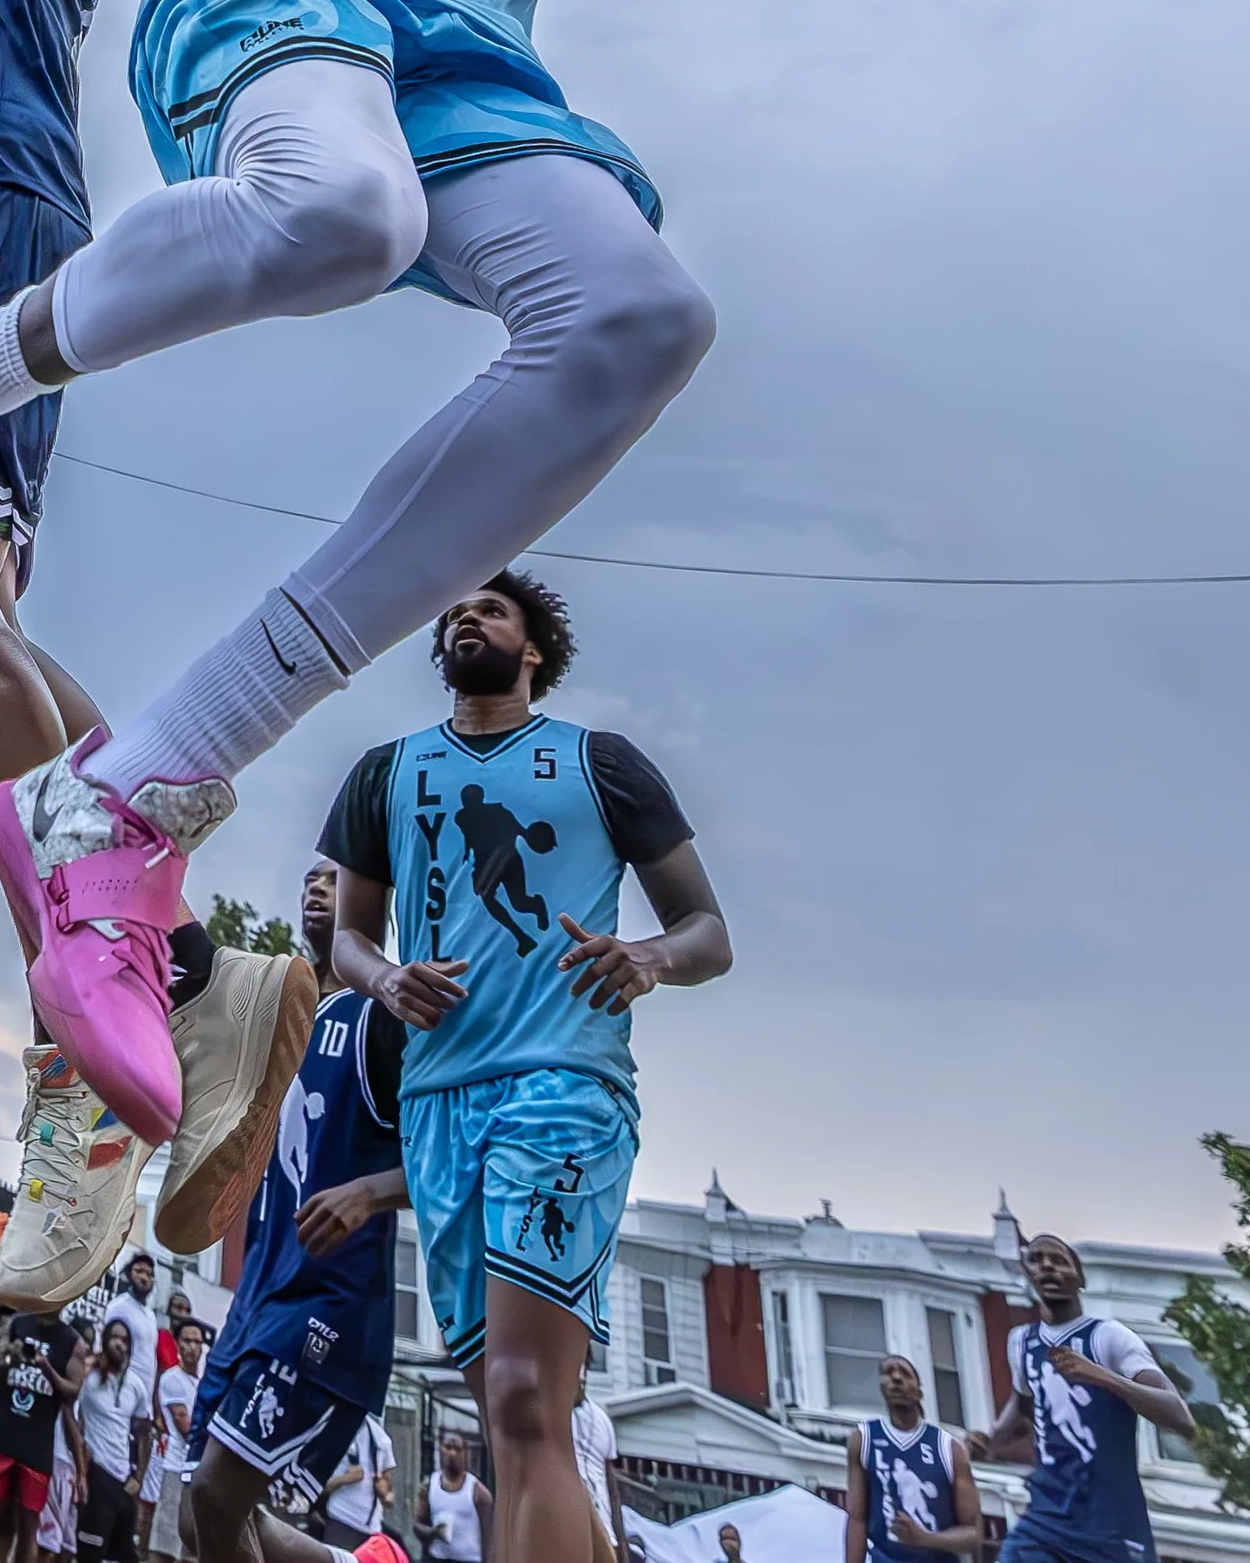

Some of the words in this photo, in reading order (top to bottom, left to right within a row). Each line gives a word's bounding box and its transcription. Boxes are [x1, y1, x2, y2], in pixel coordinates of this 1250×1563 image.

[534, 748, 557, 780] 5
[415, 770, 451, 962] LYSL
[318, 1019, 349, 1057] 10
